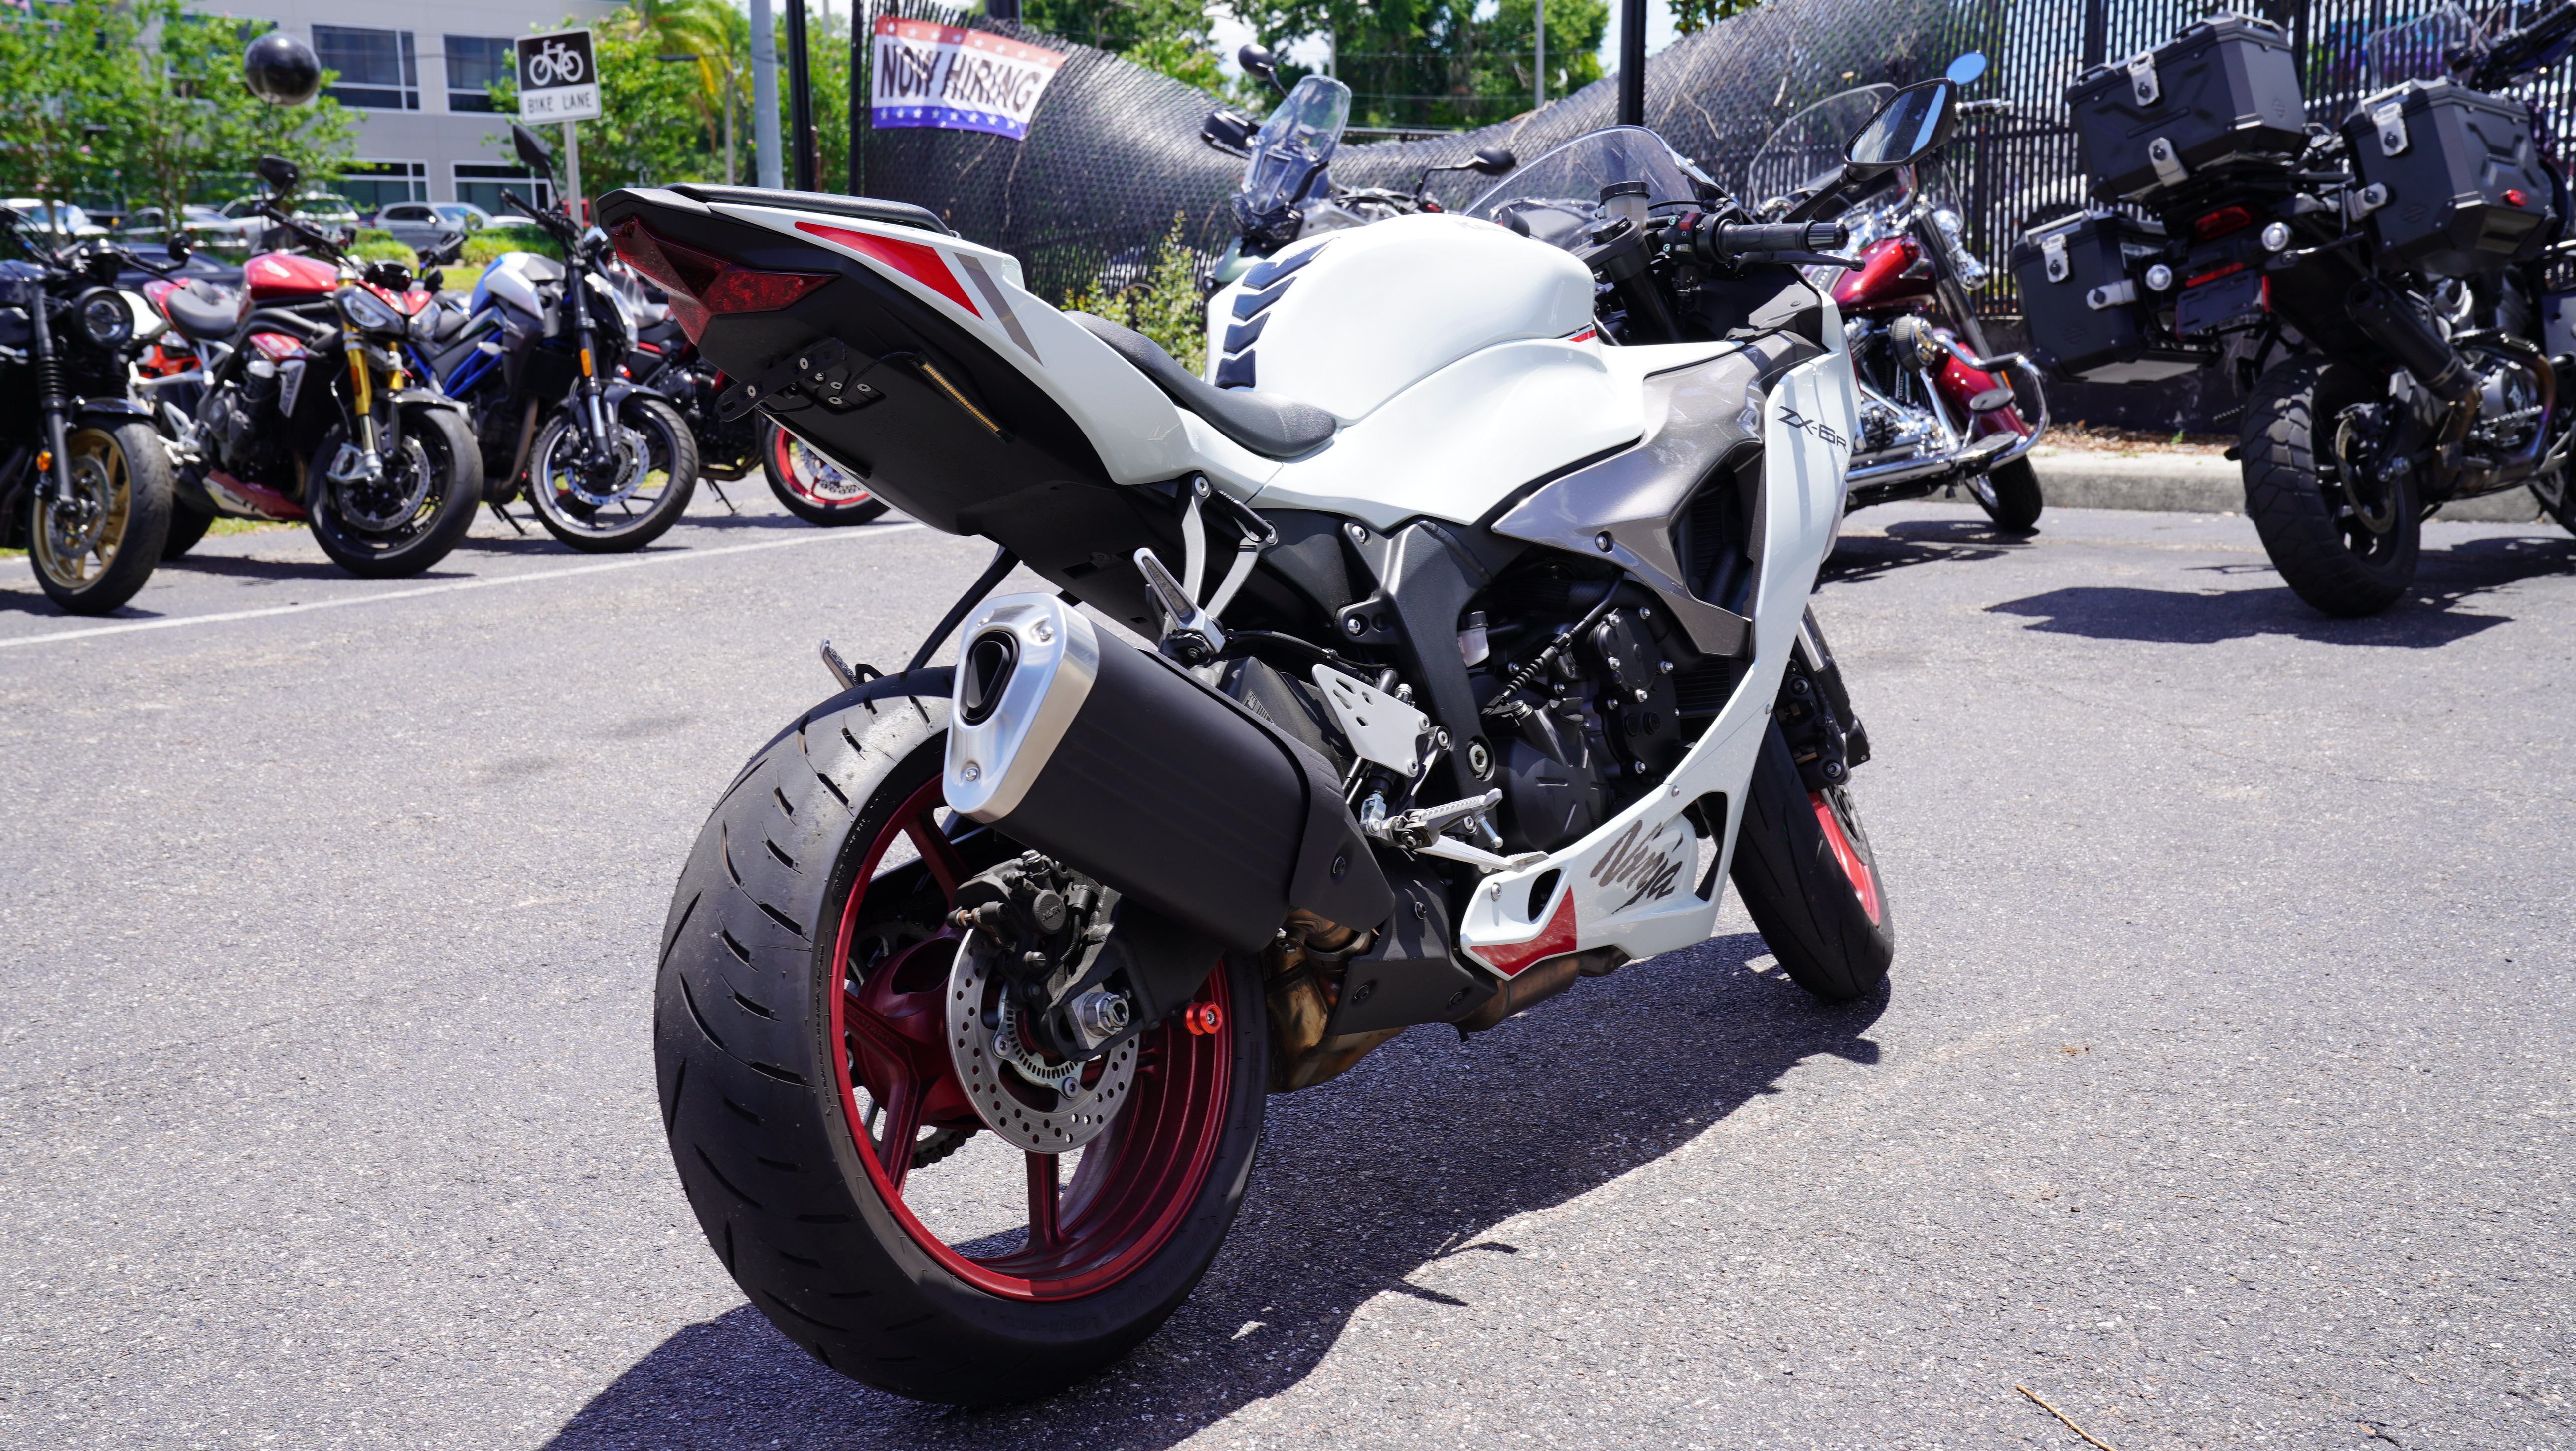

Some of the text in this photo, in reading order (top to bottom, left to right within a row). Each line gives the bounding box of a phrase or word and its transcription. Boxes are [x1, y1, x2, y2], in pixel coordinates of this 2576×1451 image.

[528, 92, 592, 114] BIKE LANE
[880, 45, 1041, 112] NOW HIRING
[1778, 406, 1848, 454] ZX-6R
[1590, 819, 1684, 914] Ninja
